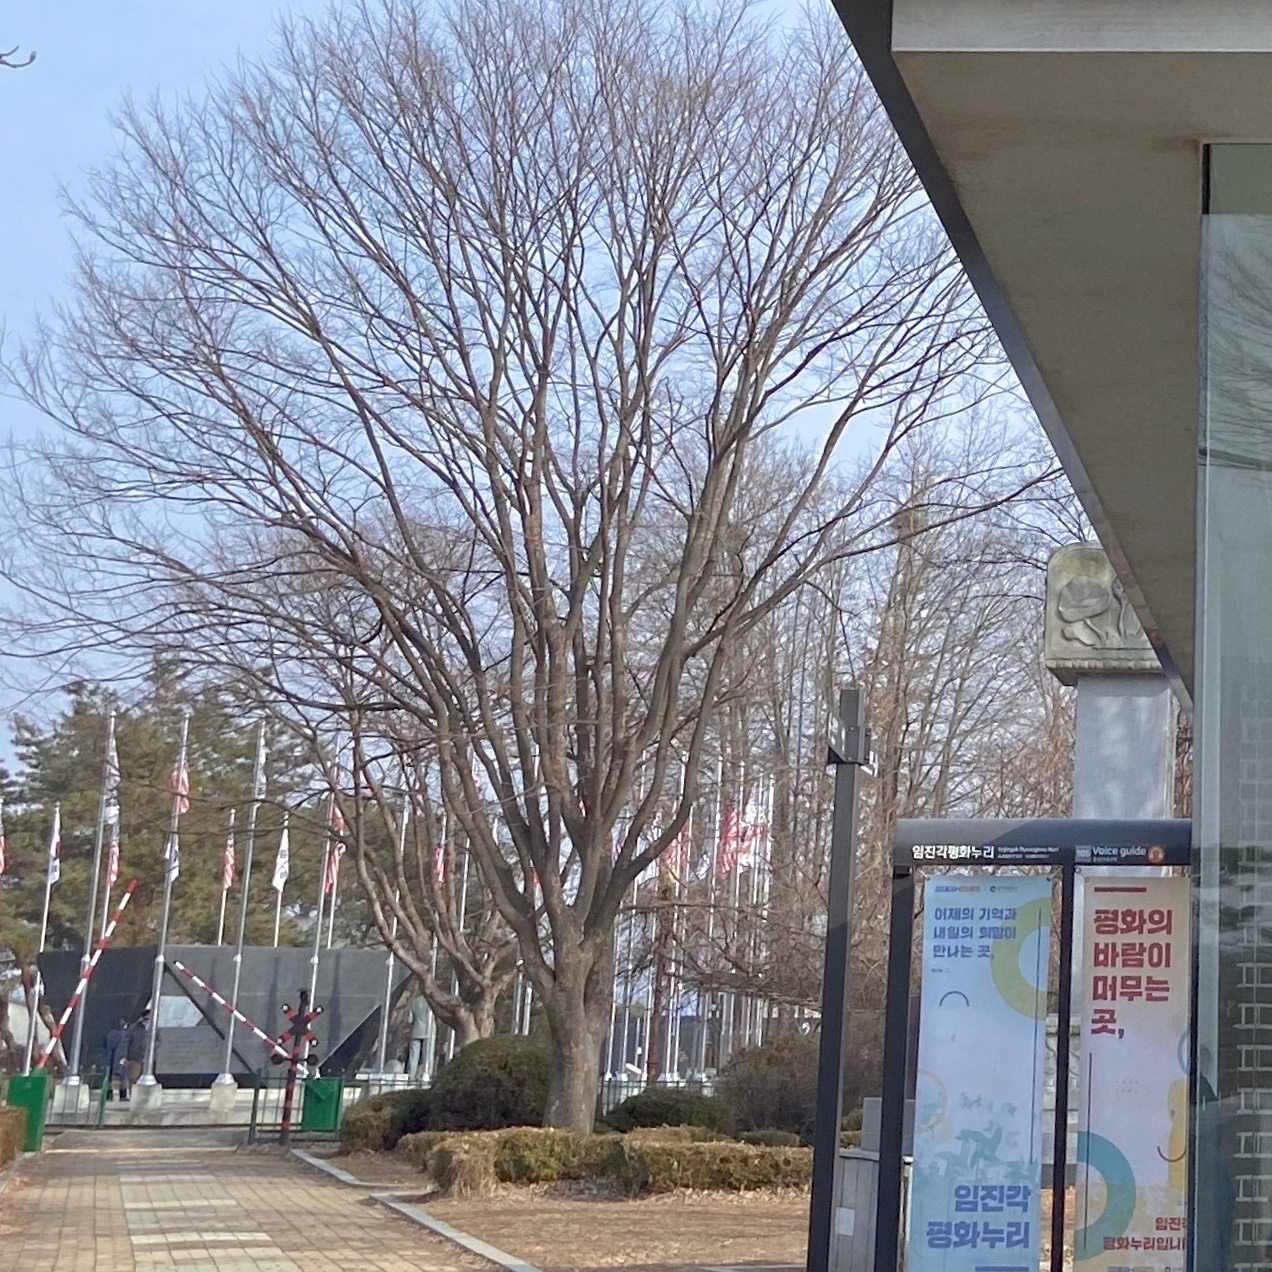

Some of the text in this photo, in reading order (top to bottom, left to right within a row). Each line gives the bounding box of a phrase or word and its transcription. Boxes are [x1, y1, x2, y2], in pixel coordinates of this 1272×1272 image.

[911, 844, 995, 860] 임진각평화누리
[1092, 846, 1146, 857] Voice guide
[978, 907, 1017, 921] 기억과
[1094, 909, 1173, 935] 평화의
[933, 926, 1017, 940] 내일의 희망이
[933, 944, 973, 958] 만나는
[1093, 942, 1171, 968] 바람이
[1092, 975, 1170, 1001] 머무는
[1091, 1008, 1125, 1039] 곳,
[954, 1185, 1031, 1213] 임진각
[926, 1221, 1030, 1249] 평화누리
[1103, 1236, 1186, 1251] 평화누리입니
